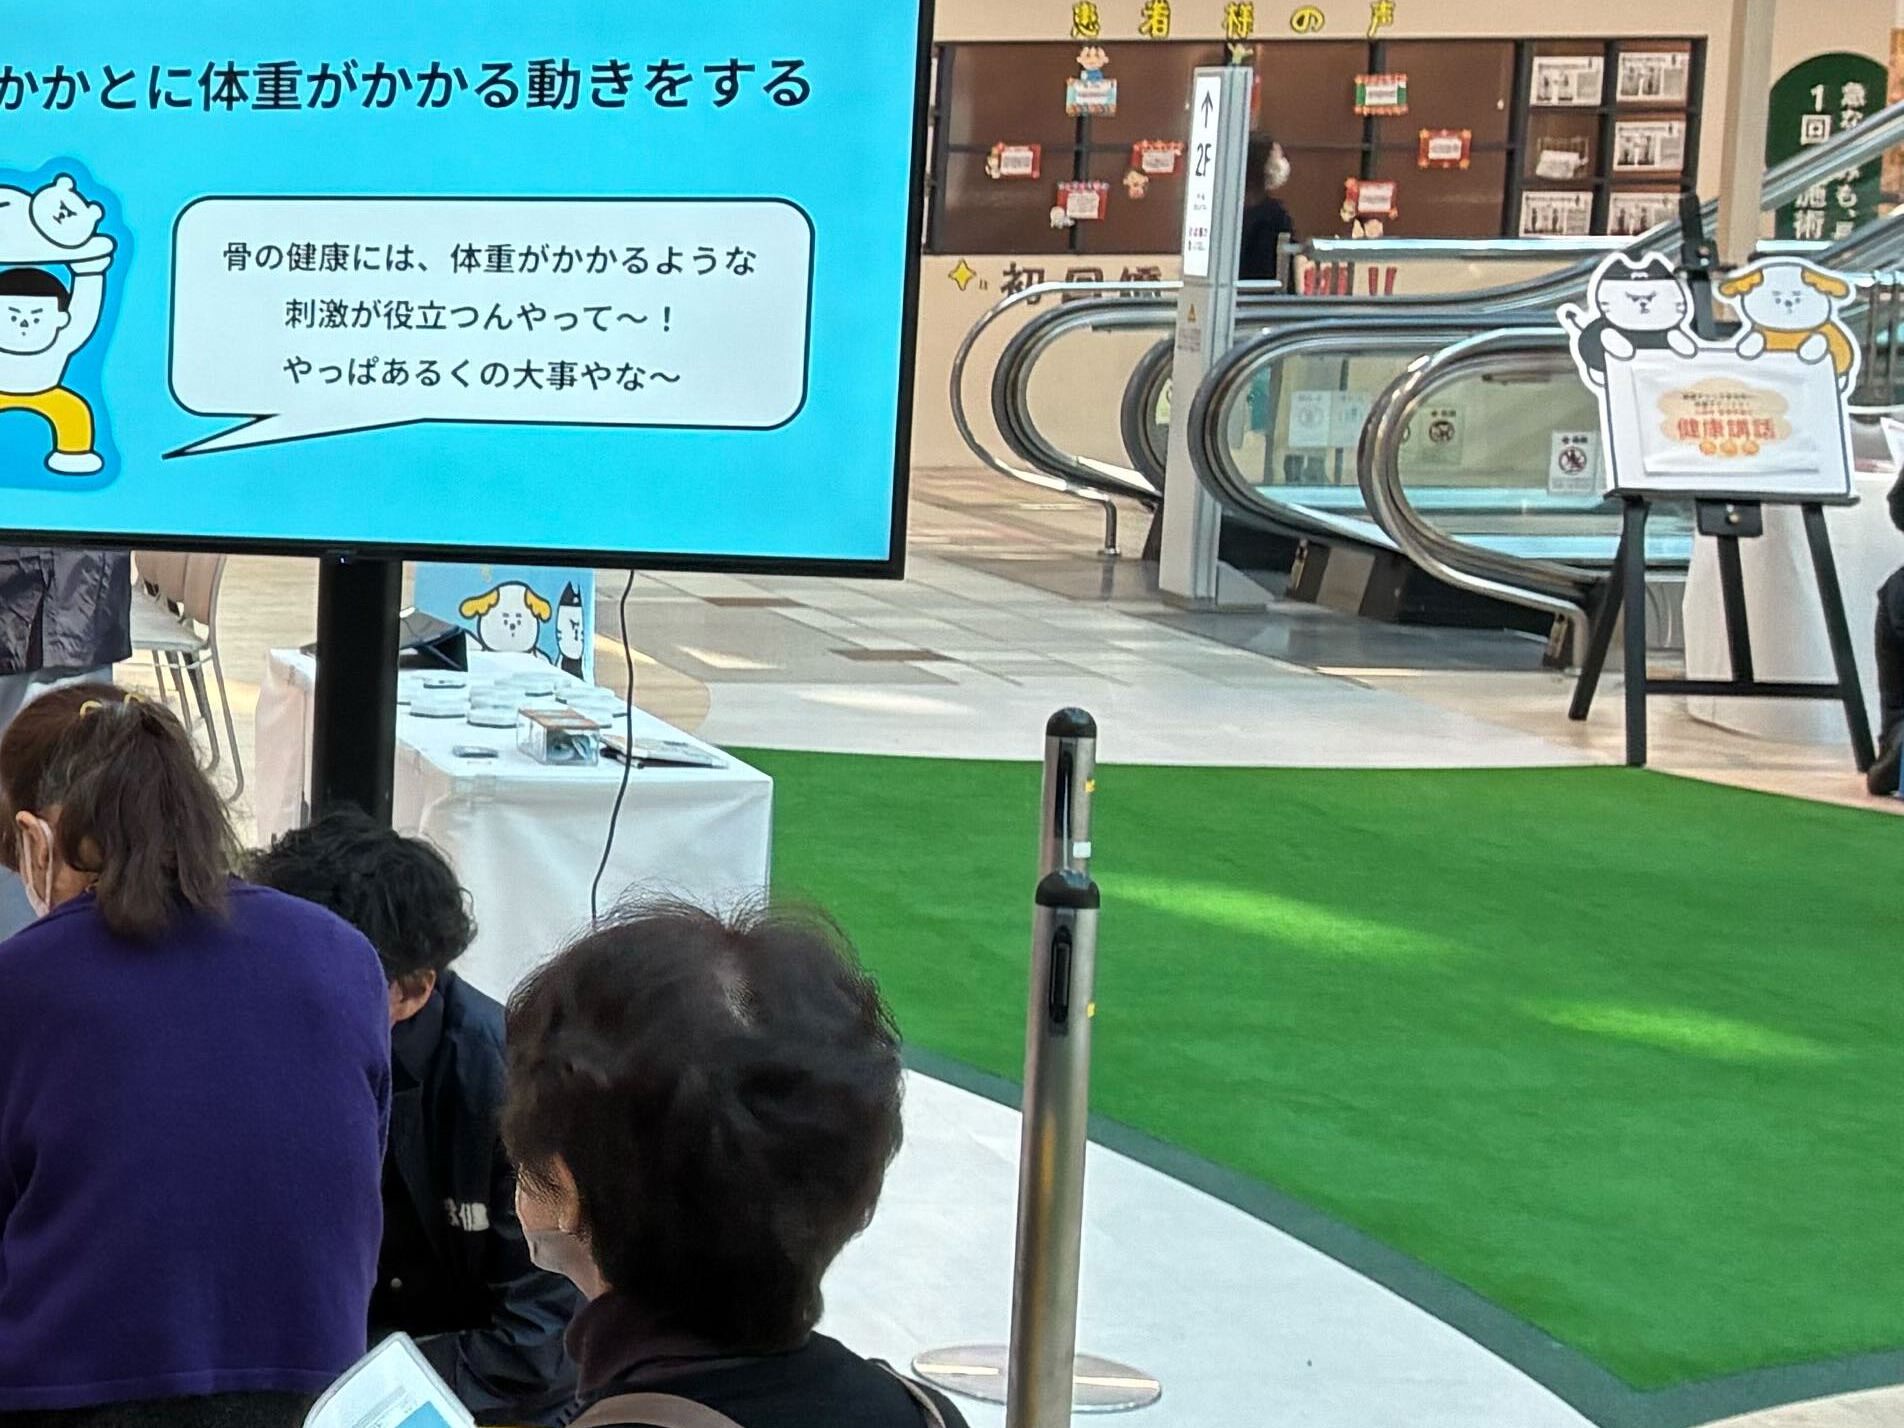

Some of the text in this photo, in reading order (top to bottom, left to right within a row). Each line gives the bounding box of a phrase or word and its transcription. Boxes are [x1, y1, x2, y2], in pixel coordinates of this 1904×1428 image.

[1195, 142, 1212, 177] 2F
[222, 241, 758, 276] 骨の健康には、体重がかかるような
[282, 355, 682, 393] やっぱあるくの大事やな〜
